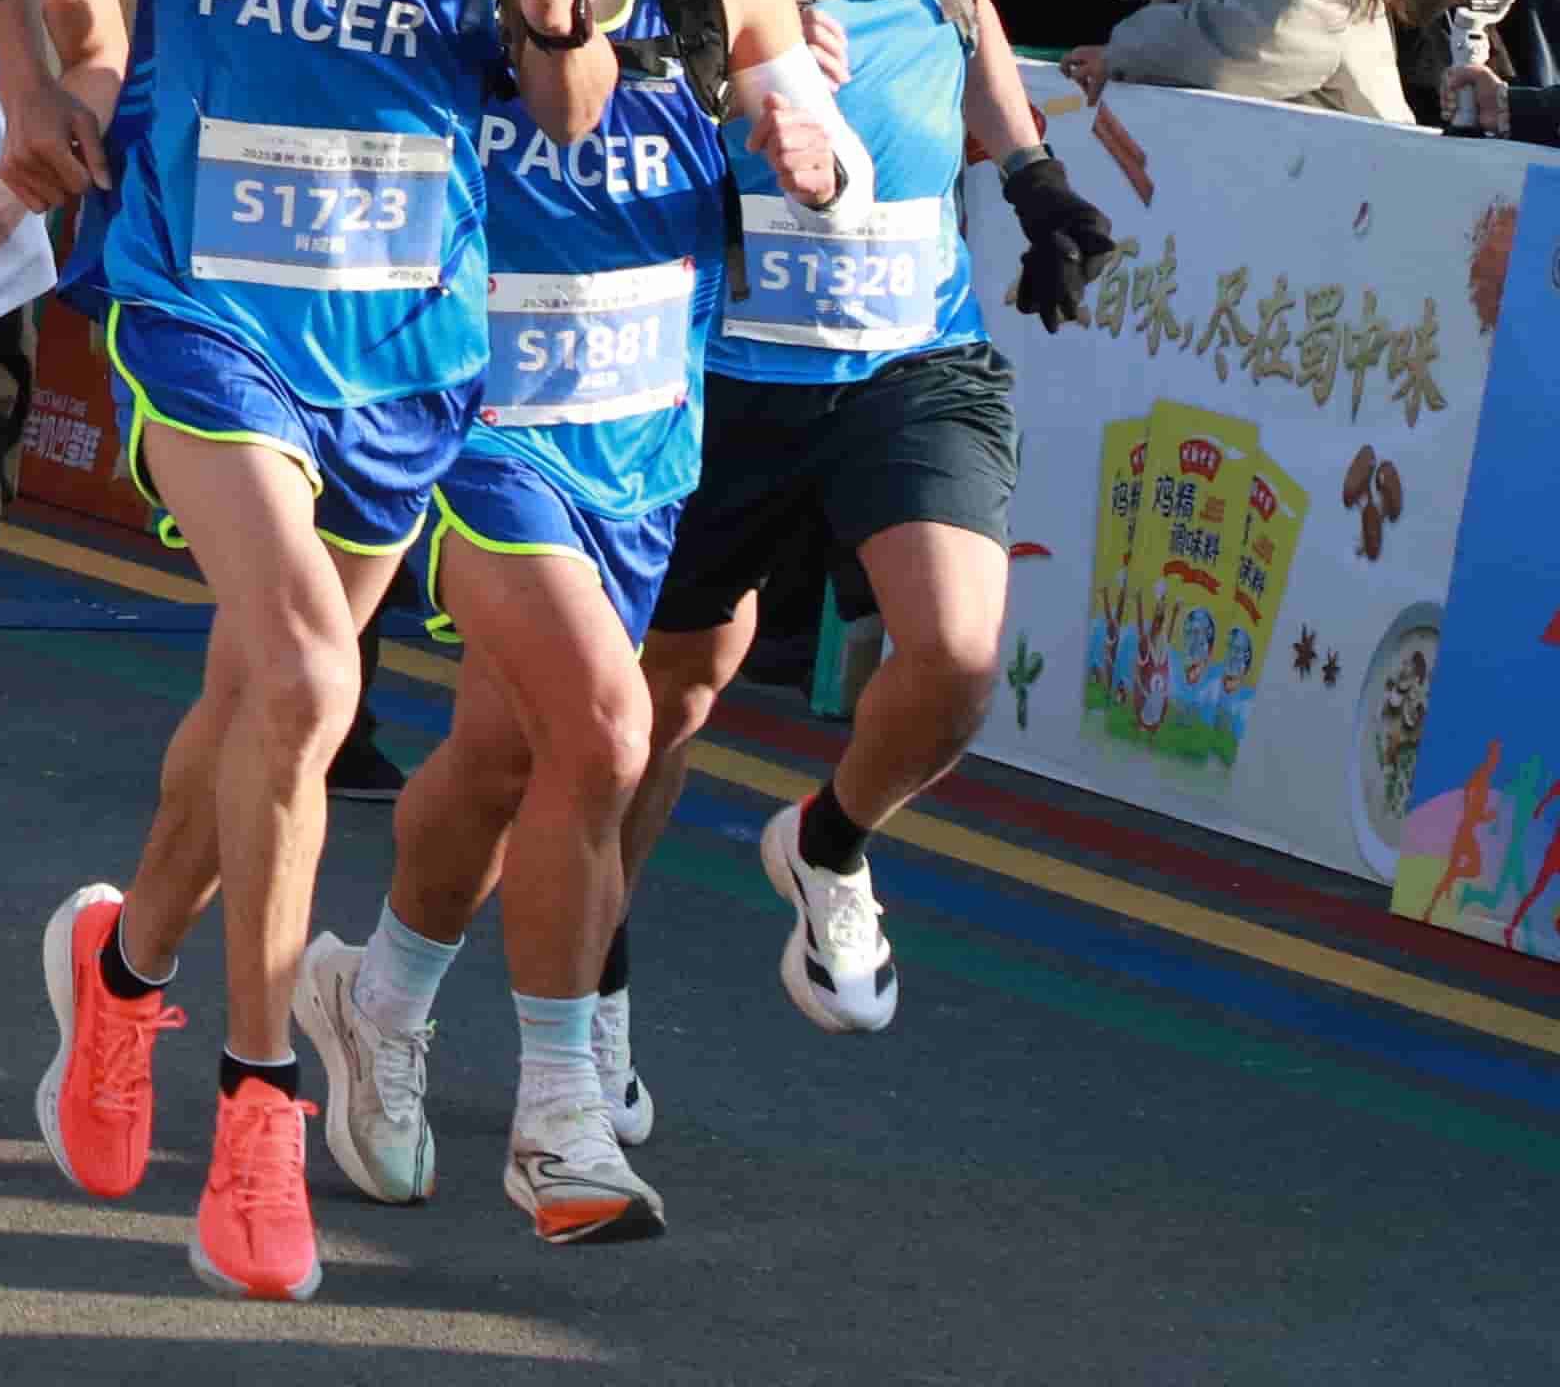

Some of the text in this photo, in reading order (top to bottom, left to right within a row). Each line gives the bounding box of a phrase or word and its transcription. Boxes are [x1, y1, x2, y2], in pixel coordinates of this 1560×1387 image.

[477, 114, 672, 194] PACER
[232, 180, 410, 232] S1723
[760, 250, 915, 297] S1328
[517, 315, 661, 372] S1881
